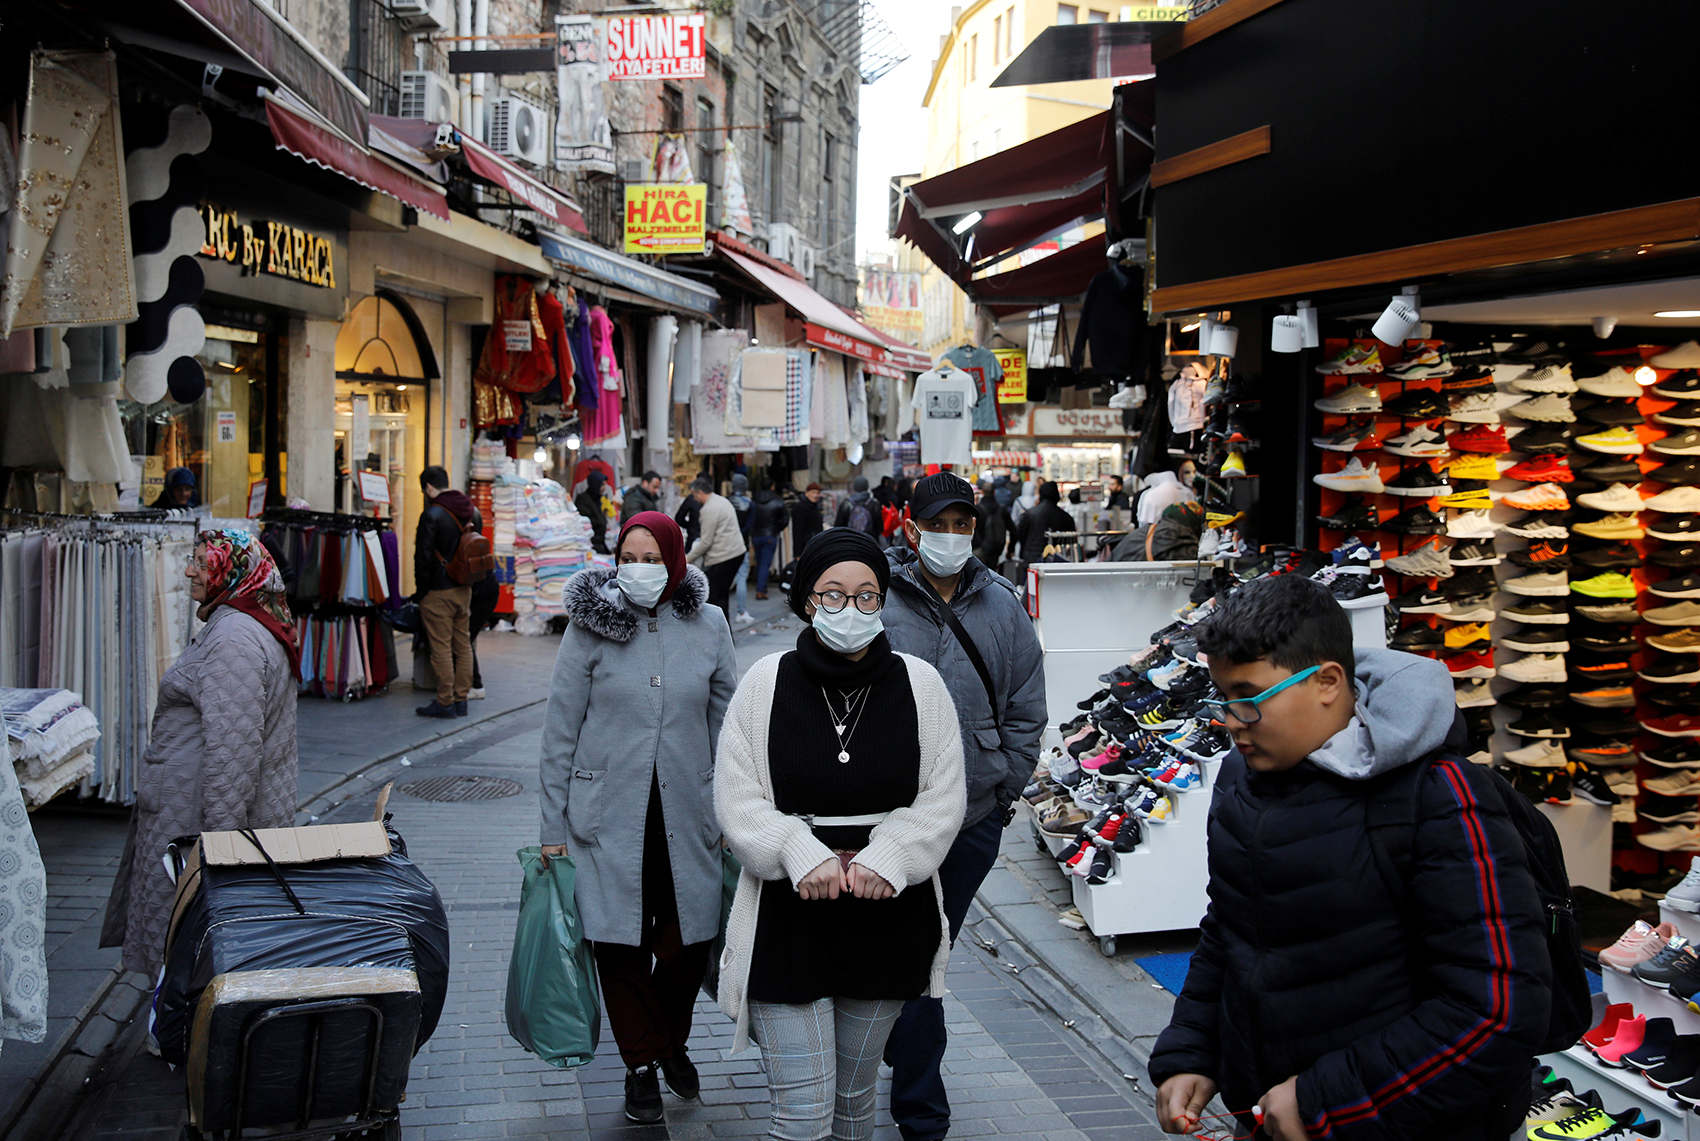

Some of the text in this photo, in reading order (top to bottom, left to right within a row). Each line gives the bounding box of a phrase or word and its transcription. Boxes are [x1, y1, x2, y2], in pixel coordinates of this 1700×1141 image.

[608, 15, 705, 60] SÜNNET
[608, 57, 706, 77] KIYAFETLERİ
[644, 189, 688, 199] HİRA
[627, 199, 702, 223] HACI
[627, 225, 702, 234] MALZEMELERİ
[267, 221, 337, 289] KARACA
[1001, 357, 1022, 369] DE
[928, 474, 967, 496] KING
